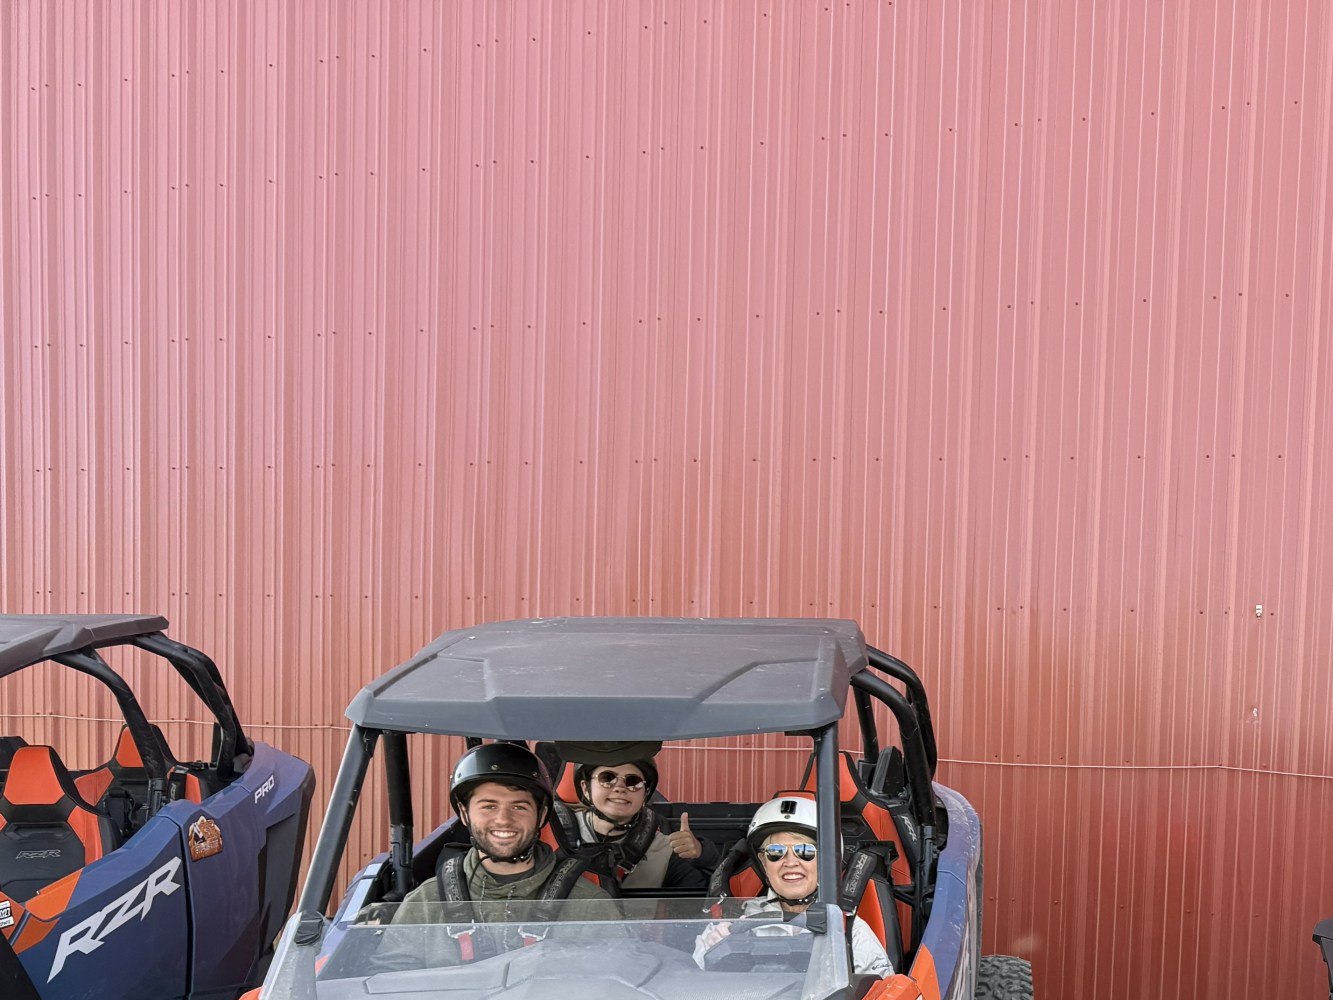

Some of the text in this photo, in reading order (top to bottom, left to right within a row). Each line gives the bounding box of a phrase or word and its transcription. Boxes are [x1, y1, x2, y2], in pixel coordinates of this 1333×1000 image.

[254, 774, 275, 804] PRO
[16, 849, 61, 859] RZR
[46, 856, 182, 985] RZR
